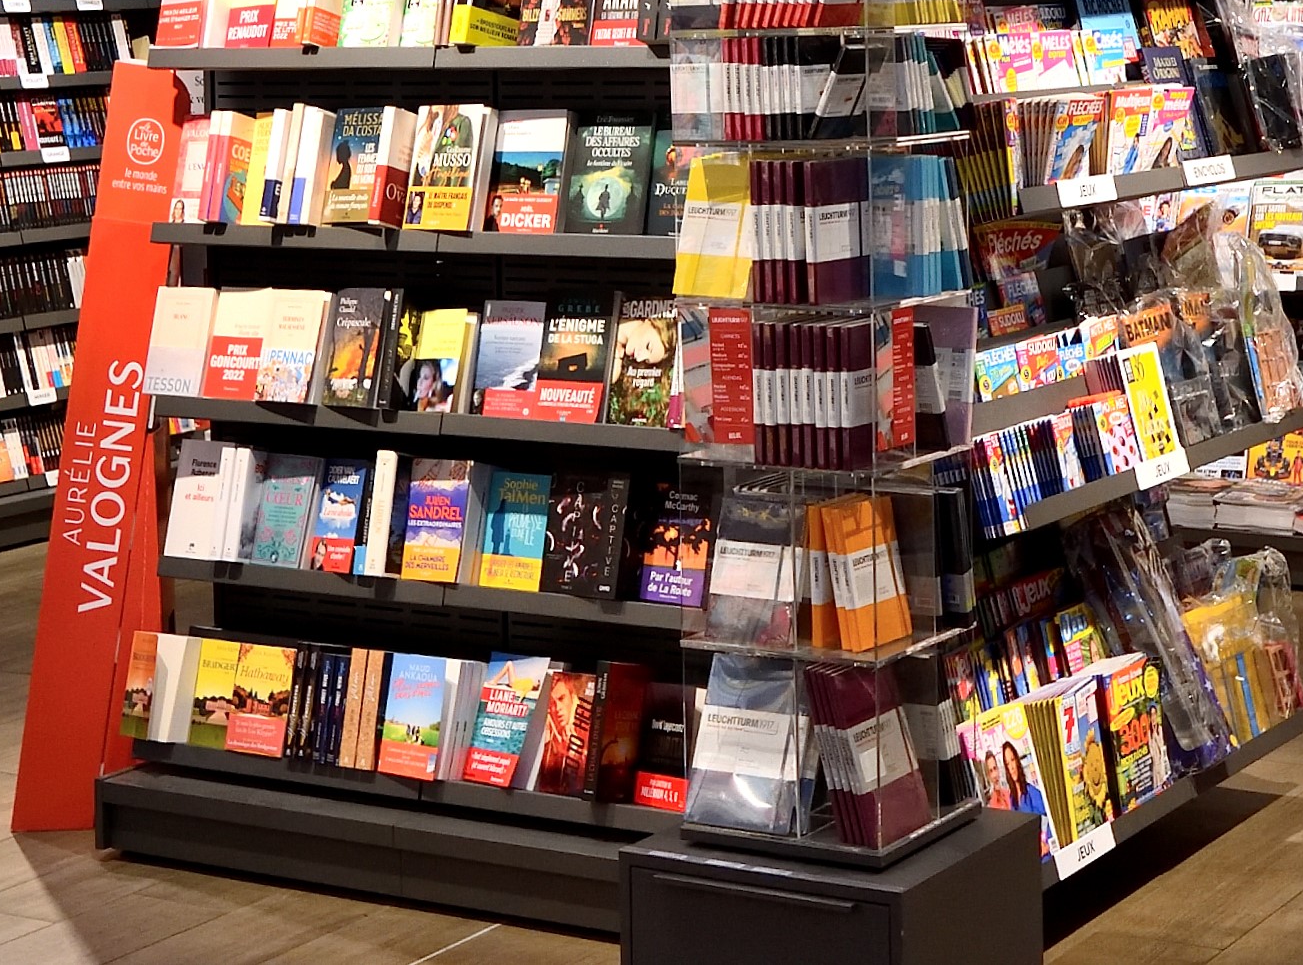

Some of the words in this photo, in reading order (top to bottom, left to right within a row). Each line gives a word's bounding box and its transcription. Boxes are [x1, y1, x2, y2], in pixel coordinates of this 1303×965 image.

[240, 9, 259, 24] PRIX
[227, 21, 268, 41] RENAUDOT
[134, 129, 159, 142] Livre
[131, 144, 159, 157] Poche
[591, 146, 631, 158] OCCULTES
[433, 151, 472, 168] MUSSO
[125, 168, 132, 178] le
[133, 171, 158, 181] monde
[112, 179, 131, 189] entre
[132, 183, 144, 191] vos
[146, 185, 167, 194] mains
[1079, 183, 1097, 197] JEUX
[1261, 185, 1302, 196] FLAT
[500, 211, 552, 229] DICKER
[548, 317, 606, 333] L'ÉNIGME
[1125, 310, 1172, 336] BATMAN
[226, 342, 249, 358] PRIX
[209, 354, 262, 370] GONCOURT
[221, 368, 245, 382] 2022
[145, 376, 191, 394] TESSON
[1155, 461, 1173, 479] JEUX
[62, 421, 97, 546] AURÉLIE
[77, 359, 145, 614] VALOGNES
[408, 504, 463, 522] SANDREL
[489, 688, 517, 703] LIANE
[486, 700, 528, 717] MORIARTY
[1077, 840, 1097, 862] JEUX
